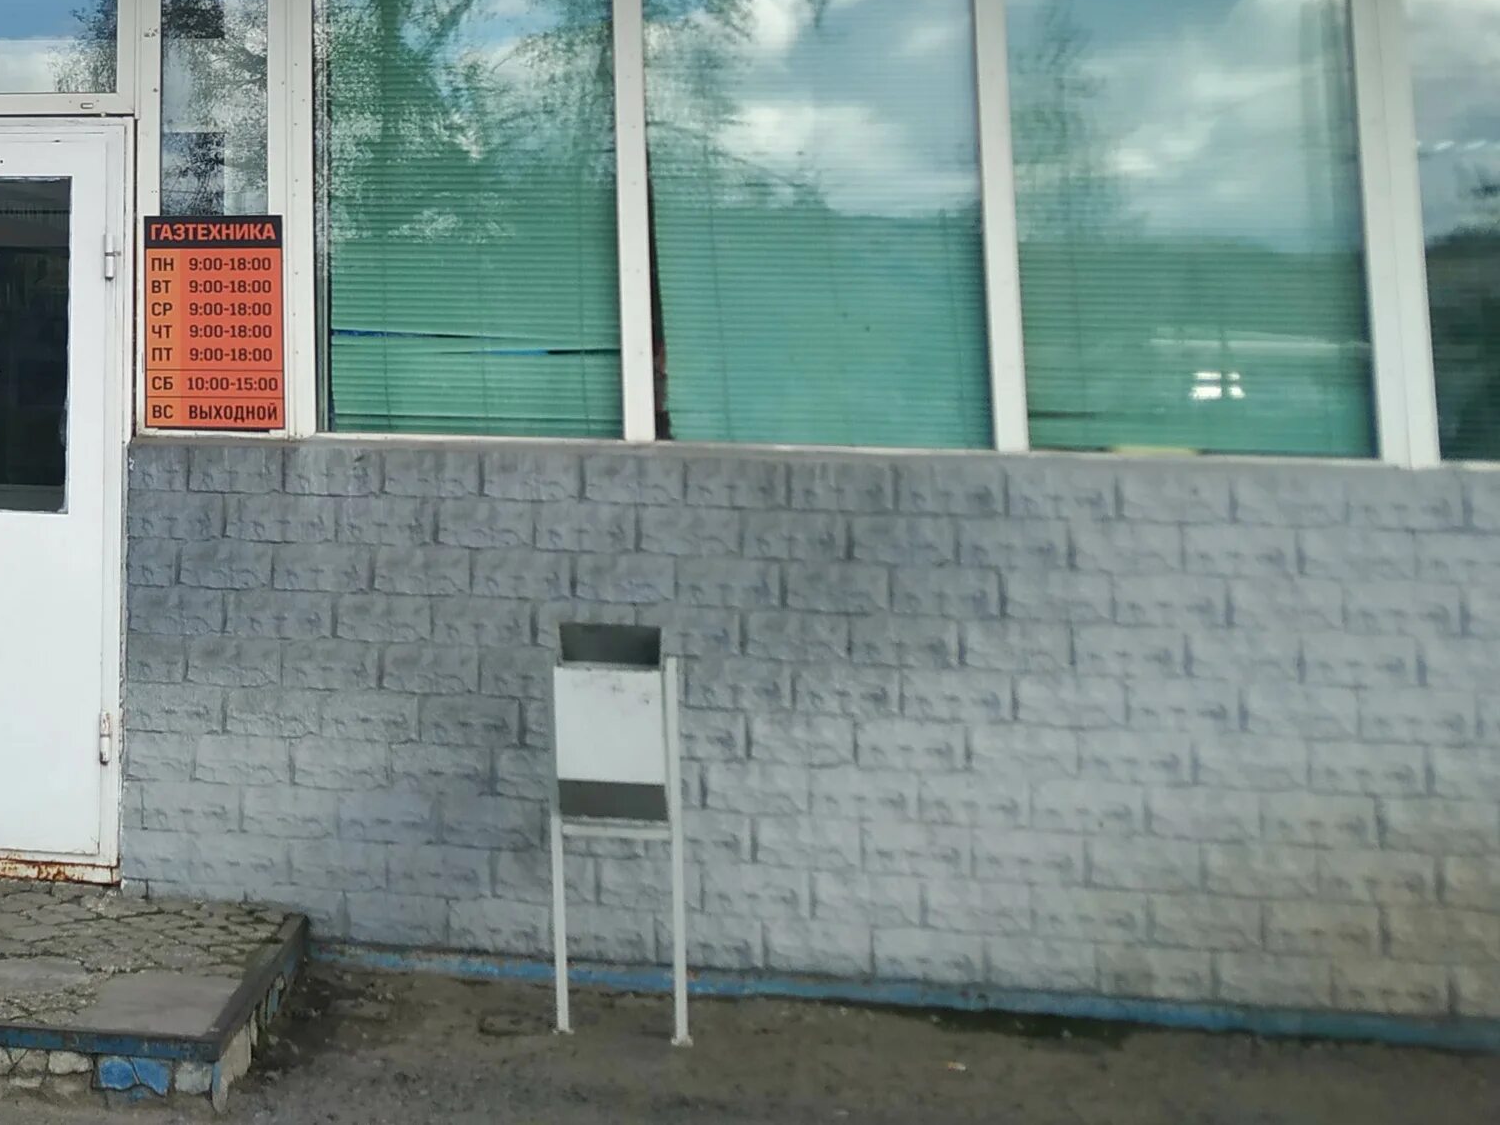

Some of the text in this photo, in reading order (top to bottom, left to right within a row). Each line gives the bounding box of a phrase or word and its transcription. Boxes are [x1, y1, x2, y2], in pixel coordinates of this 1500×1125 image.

[150, 223, 277, 242] ГАЗТЕХНИКА
[151, 257, 272, 272] ПН 9:00-18:00
[151, 280, 272, 294] ВТ 9:00-18:00
[151, 302, 272, 317] СР 9:00-18:00
[151, 324, 272, 339] ЧТ 9:00-18:00
[151, 347, 272, 362] ПТ 9:00-18:00
[151, 376, 279, 392] СБ 10:00-15:00
[152, 402, 278, 423] ВС ВЫХОДНОЙ
